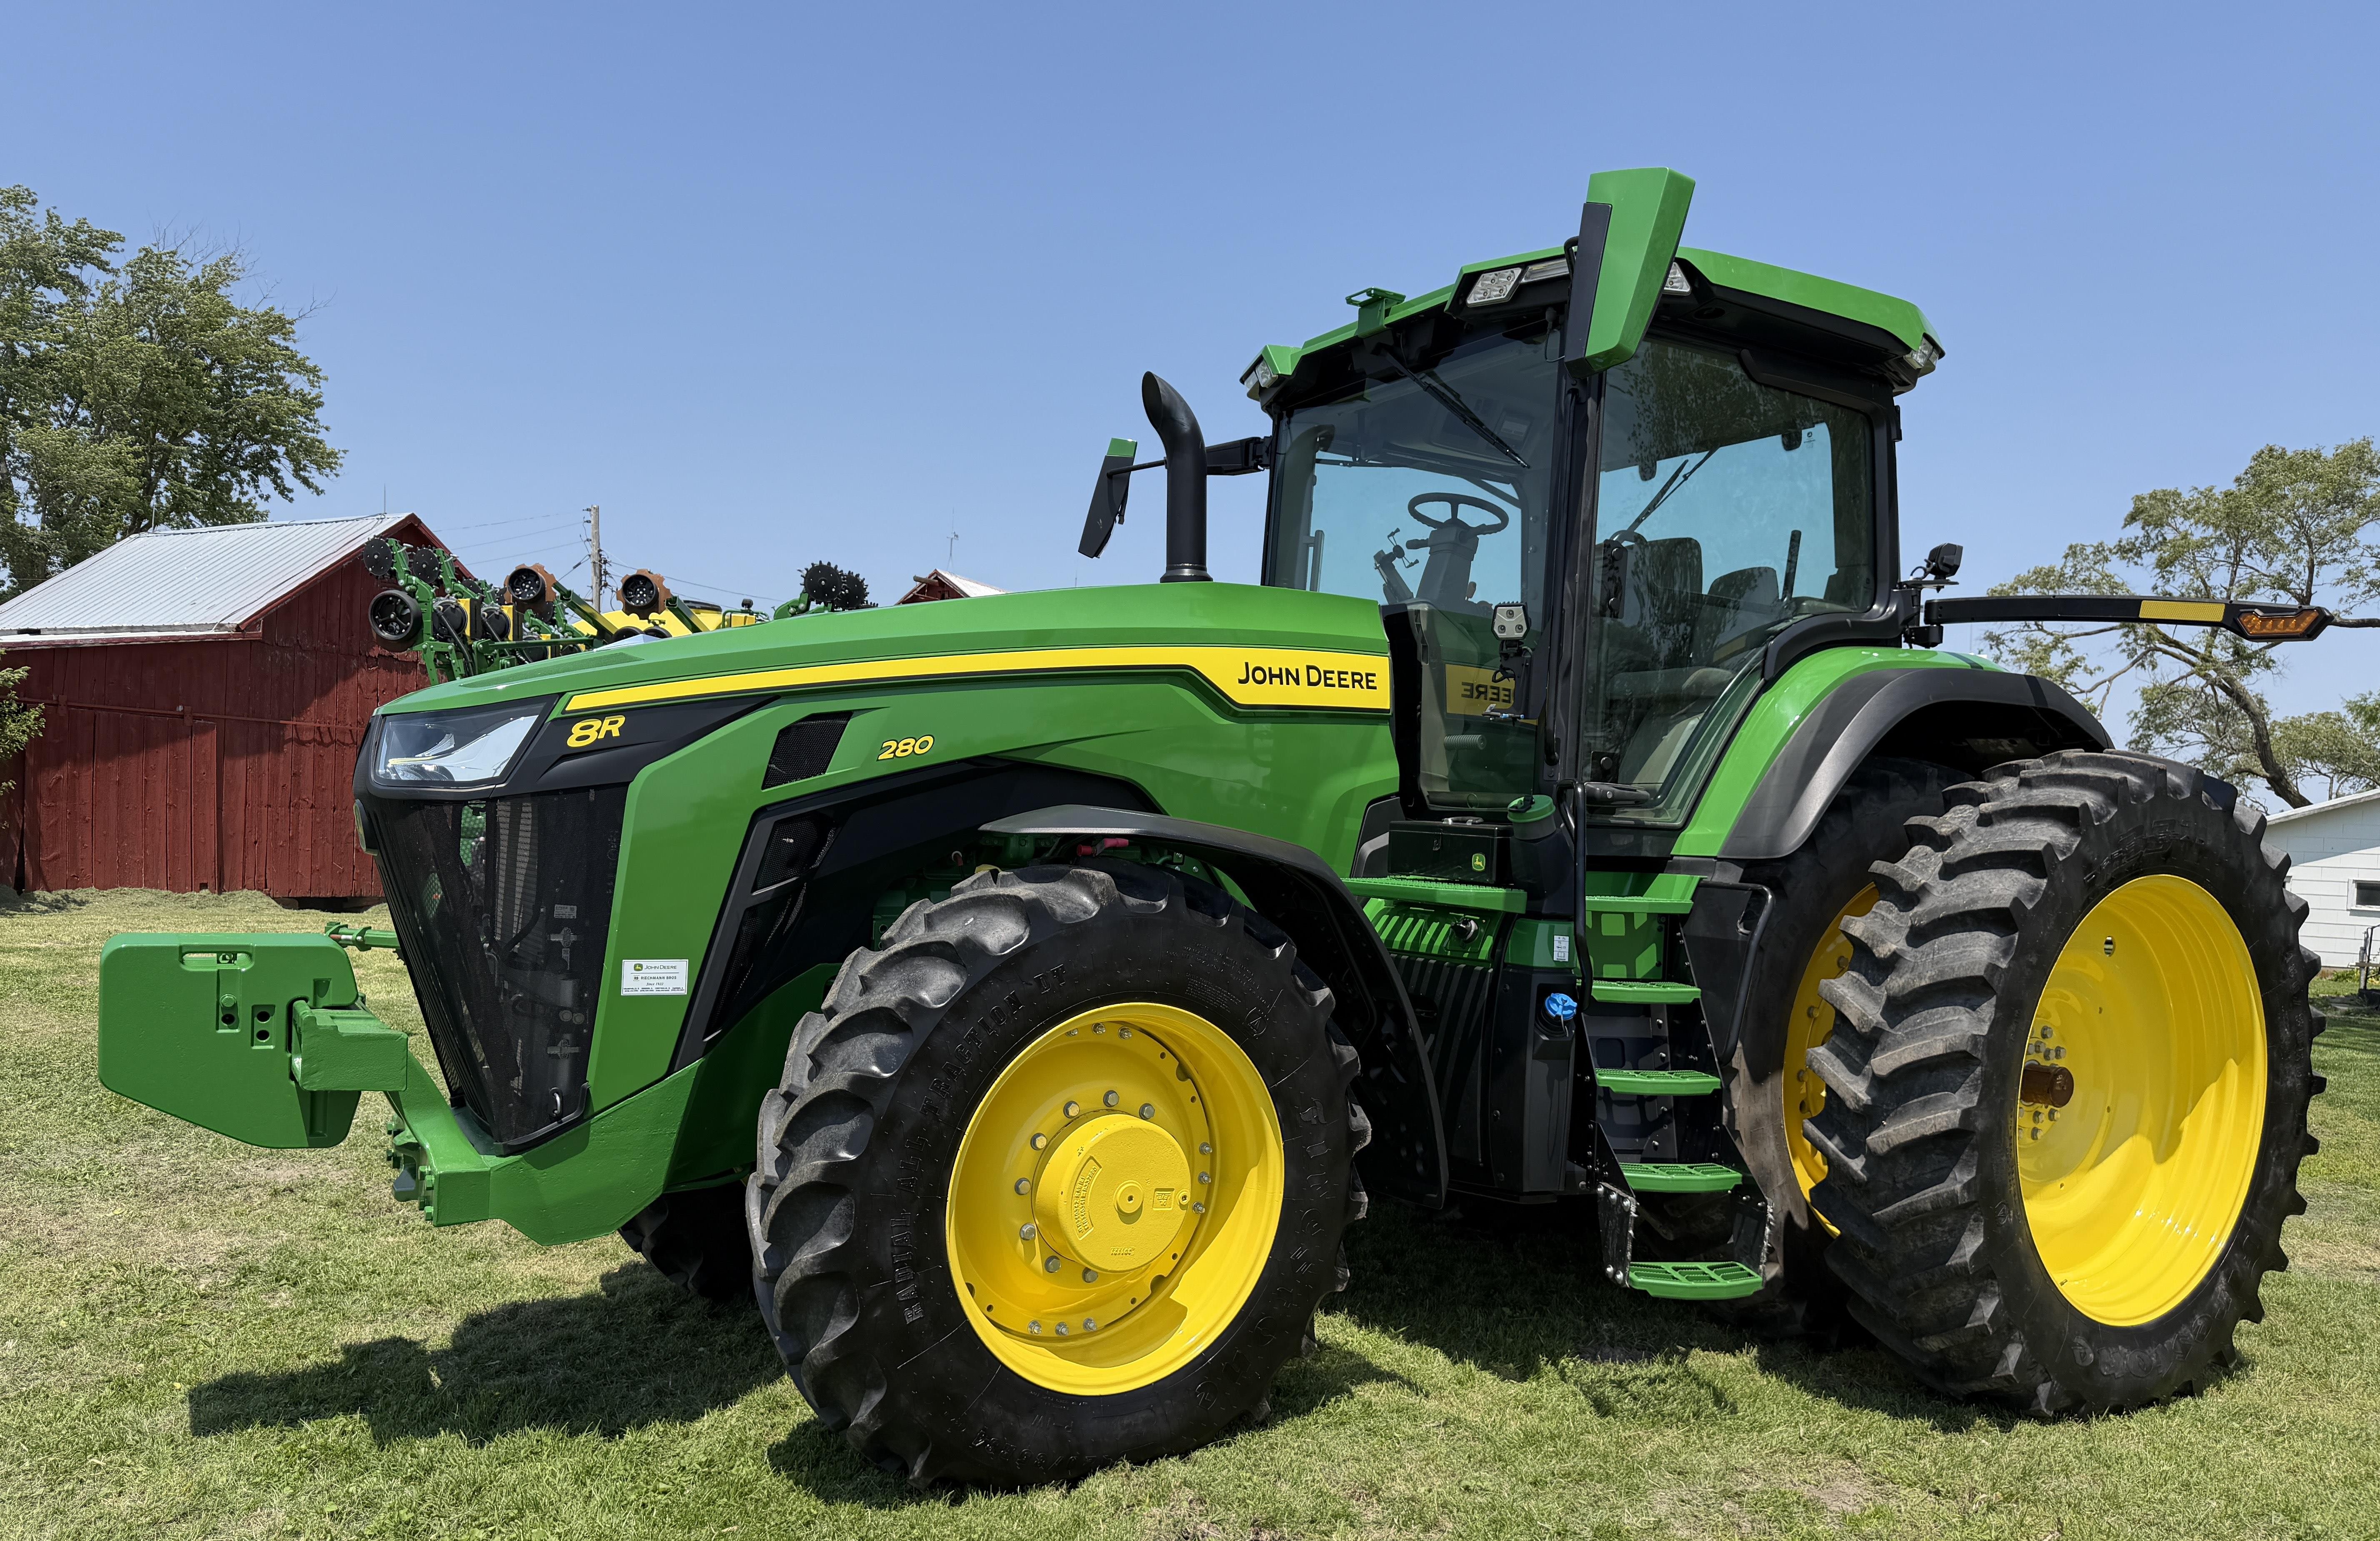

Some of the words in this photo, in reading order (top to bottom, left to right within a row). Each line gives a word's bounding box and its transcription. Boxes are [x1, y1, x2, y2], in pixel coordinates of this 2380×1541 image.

[1238, 661, 1300, 686] JOHN
[1307, 665, 1377, 690] DEERE
[567, 715, 625, 748] 8R
[877, 736, 935, 761] 280
[1033, 963, 1067, 994] DT
[919, 990, 1025, 1117] TRACTION
[897, 1136, 929, 1191] ALL
[891, 1210, 925, 1325] RADIAL
